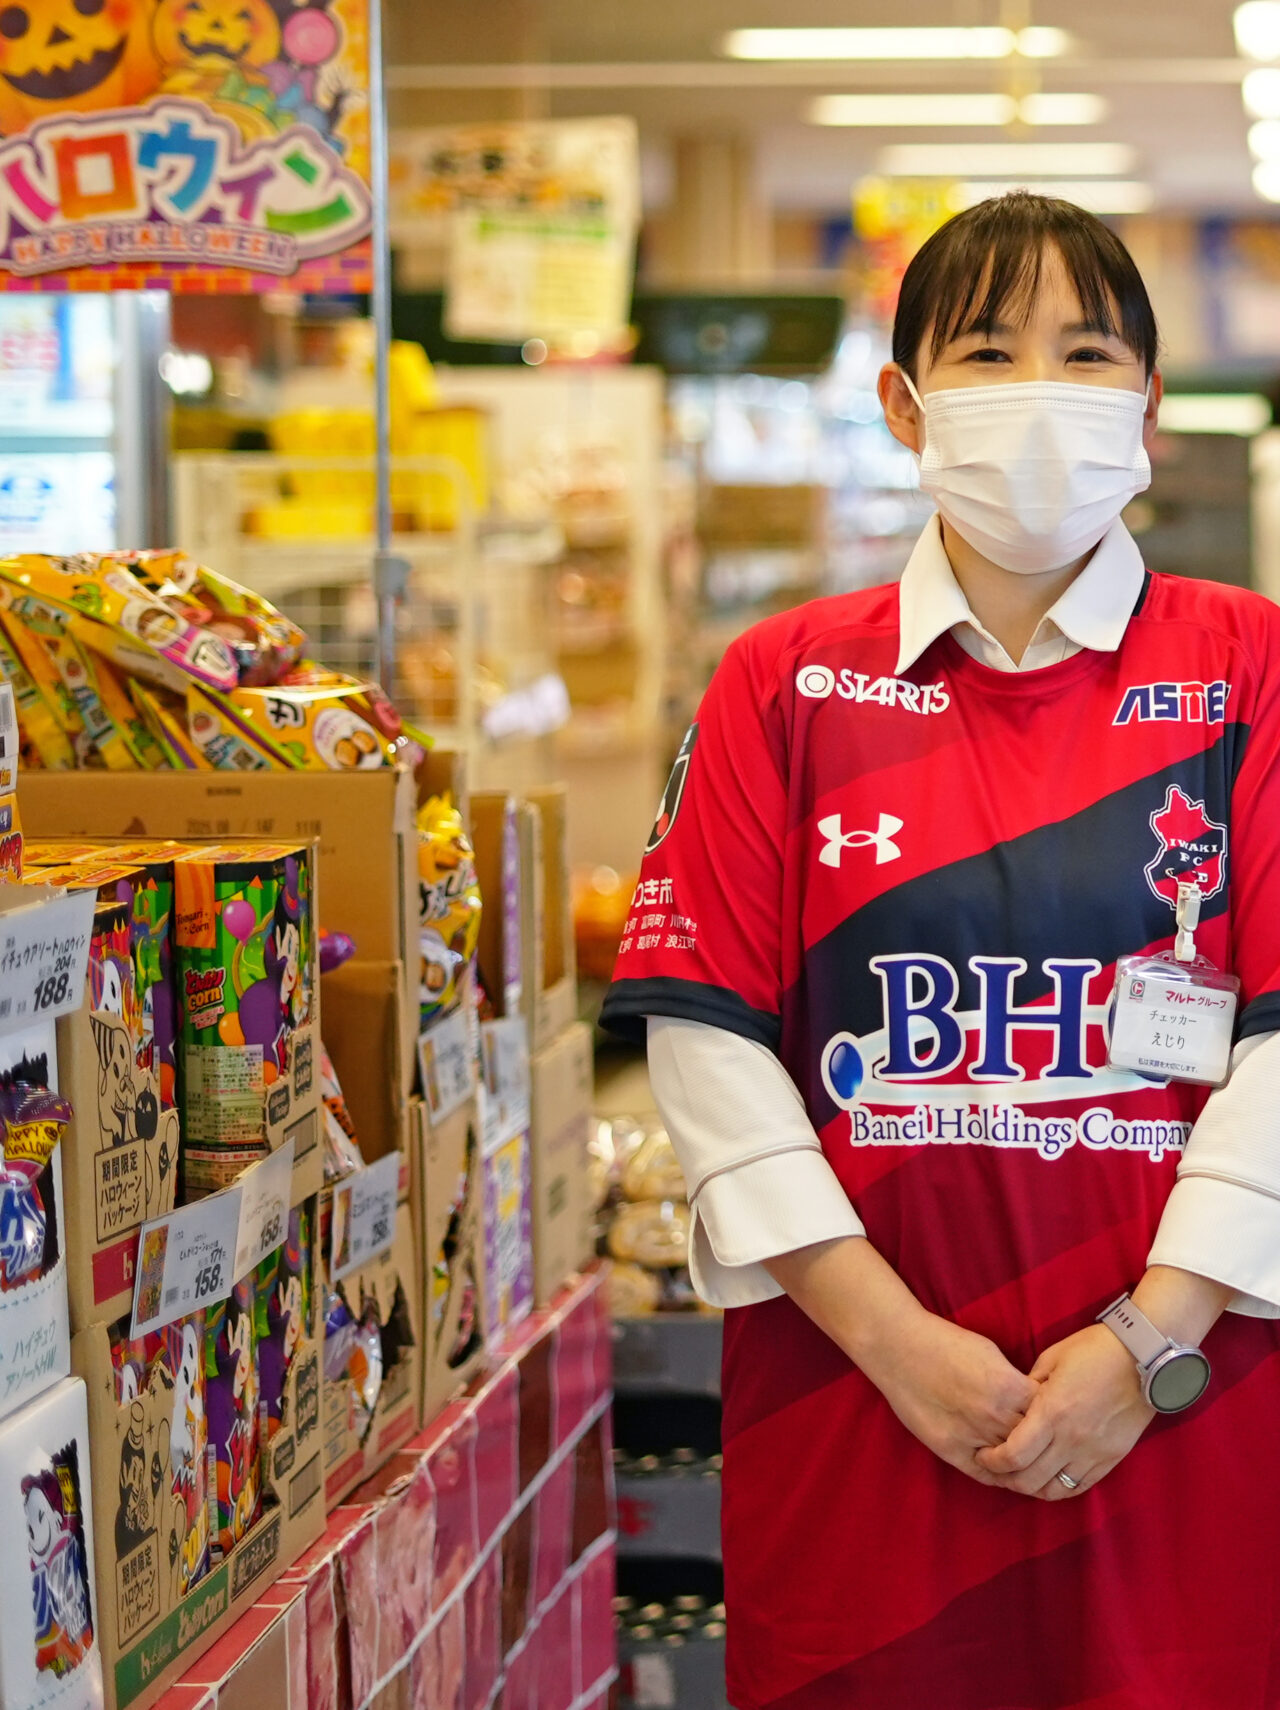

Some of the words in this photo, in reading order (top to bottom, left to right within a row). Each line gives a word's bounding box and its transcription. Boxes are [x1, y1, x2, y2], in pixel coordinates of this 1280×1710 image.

[835, 668, 951, 716] STARTS
[1111, 680, 1231, 726] ASTE
[1169, 838, 1219, 853] IWAKI
[187, 987, 222, 1012] corn
[869, 953, 1112, 1081] BH
[1149, 1009, 1198, 1026] チェッカー
[1151, 1032, 1185, 1050] えじり
[853, 1110, 925, 1141] Banei
[934, 1107, 1073, 1154] Holdings
[101, 1150, 138, 1183] 期間限定
[100, 1175, 142, 1207] ハロウィーン
[102, 1194, 140, 1230] パッケージ
[120, 1569, 156, 1612] ハロウィーン
